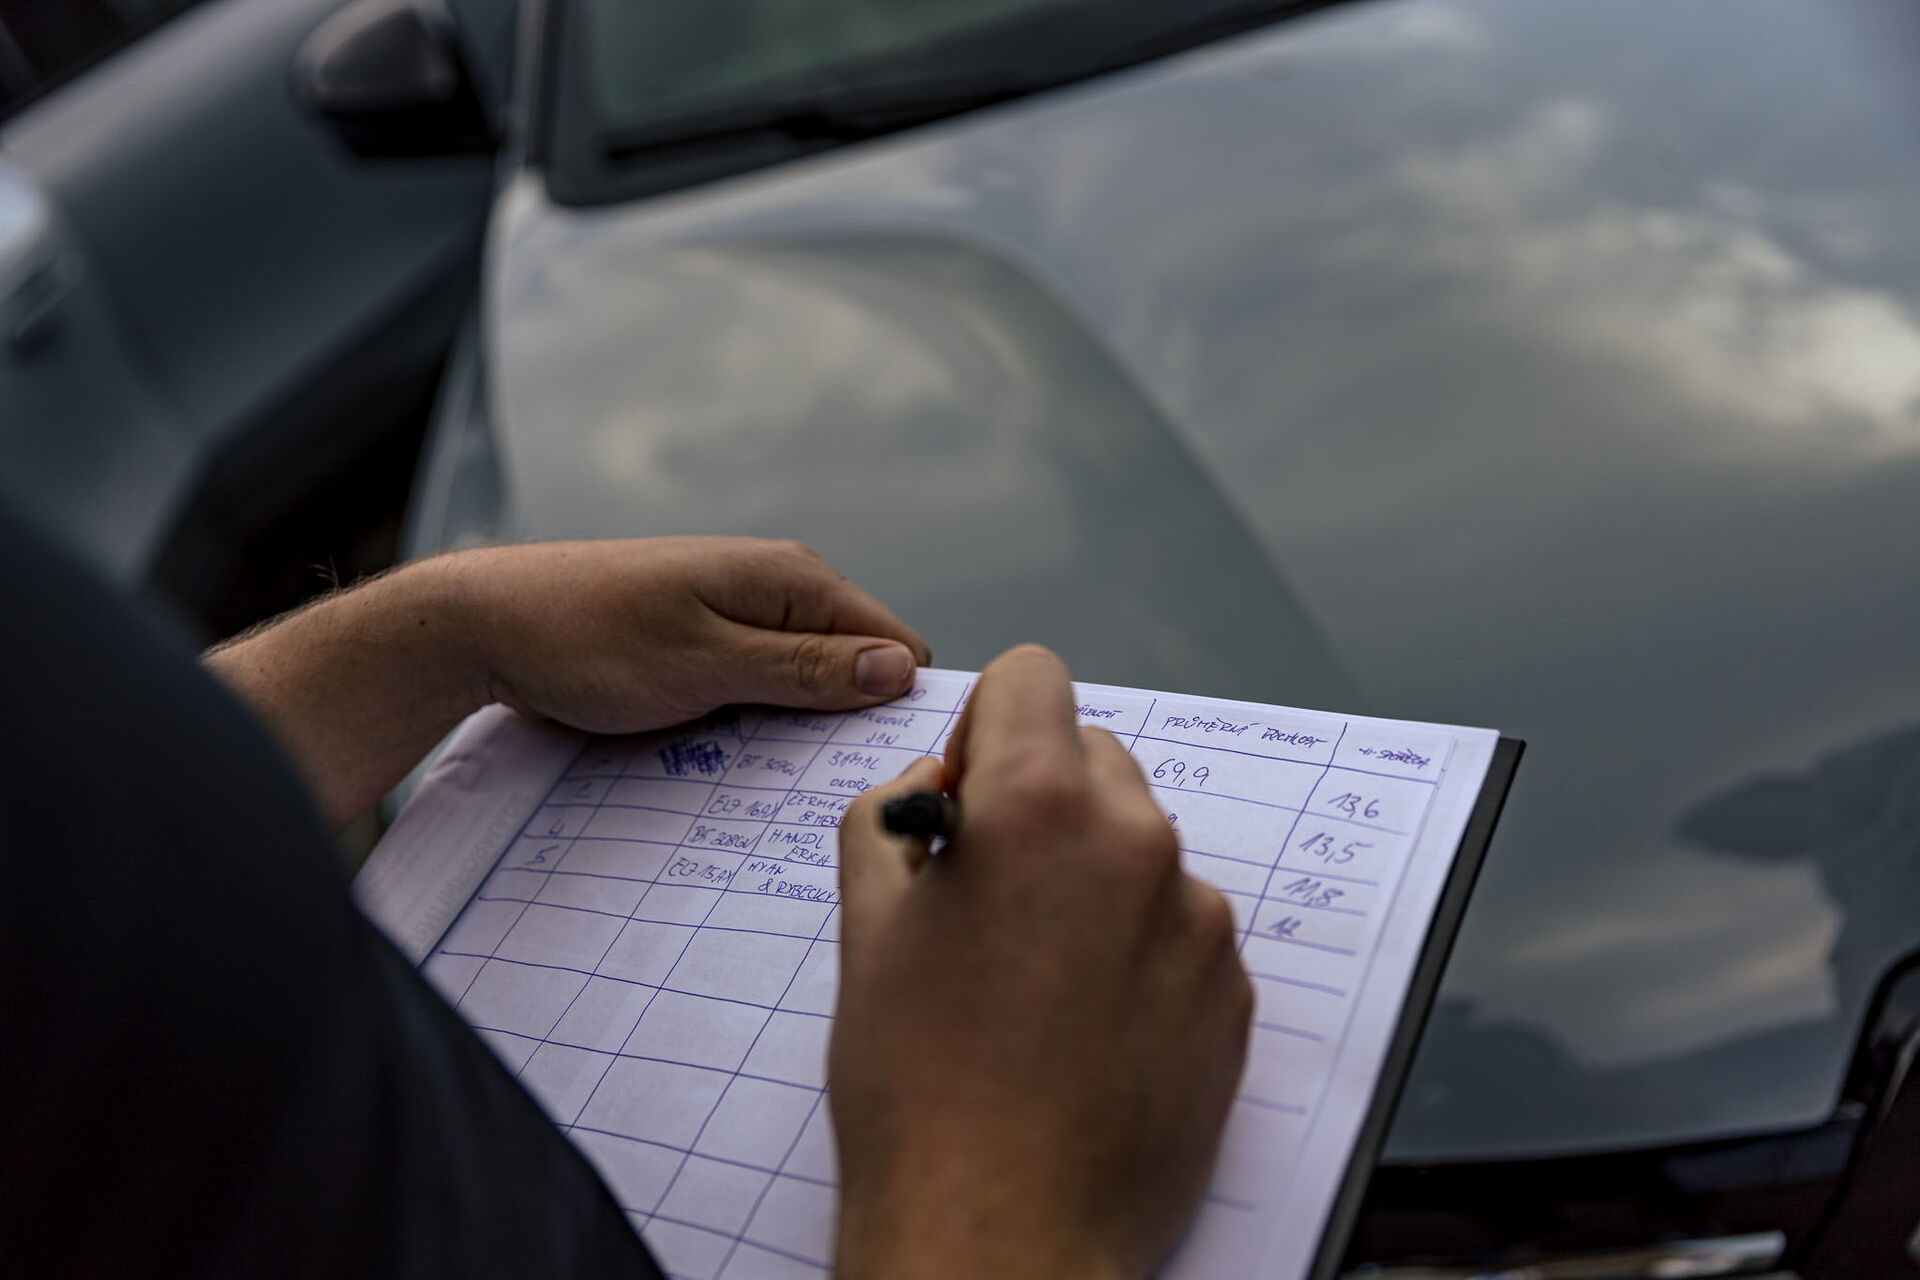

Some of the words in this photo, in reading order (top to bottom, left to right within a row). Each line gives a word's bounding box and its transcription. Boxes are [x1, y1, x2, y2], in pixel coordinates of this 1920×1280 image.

[865, 731, 901, 746] JAN
[1153, 758, 1210, 788] 69,9
[1327, 793, 1380, 819] 13,6
[767, 828, 825, 850] HANDL
[1299, 832, 1375, 865] 13,5
[783, 846, 832, 867] ERICH
[757, 877, 774, 894] &
